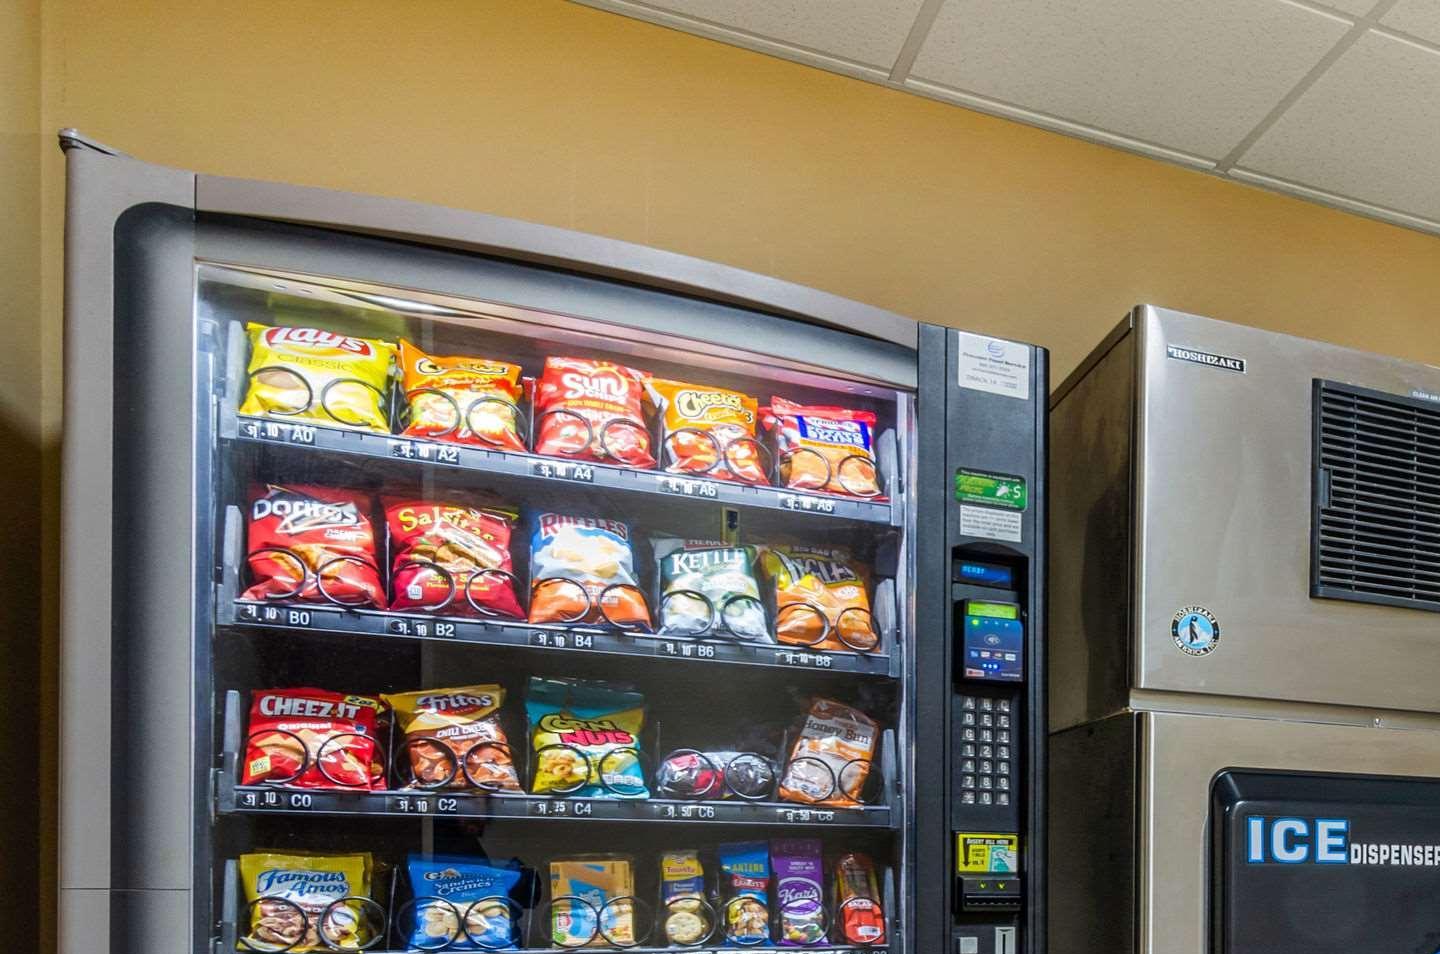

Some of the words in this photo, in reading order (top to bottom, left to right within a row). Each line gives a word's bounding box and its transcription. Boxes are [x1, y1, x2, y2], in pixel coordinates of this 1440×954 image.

[1168, 347, 1242, 370] HOSHIZAKI
[292, 429, 312, 443] A0
[437, 449, 458, 461] A2
[573, 468, 593, 480] A4
[290, 611, 310, 626] B0
[436, 623, 455, 637] B2
[575, 635, 593, 647] B4
[697, 645, 714, 657] B6
[416, 694, 493, 713] Fritos
[559, 729, 634, 747] NUTS
[291, 794, 312, 808] C0
[438, 799, 457, 812] C2
[575, 802, 592, 815] C4
[1246, 817, 1349, 865] ICE
[257, 868, 346, 894] Famous
[286, 880, 348, 898] Amos
